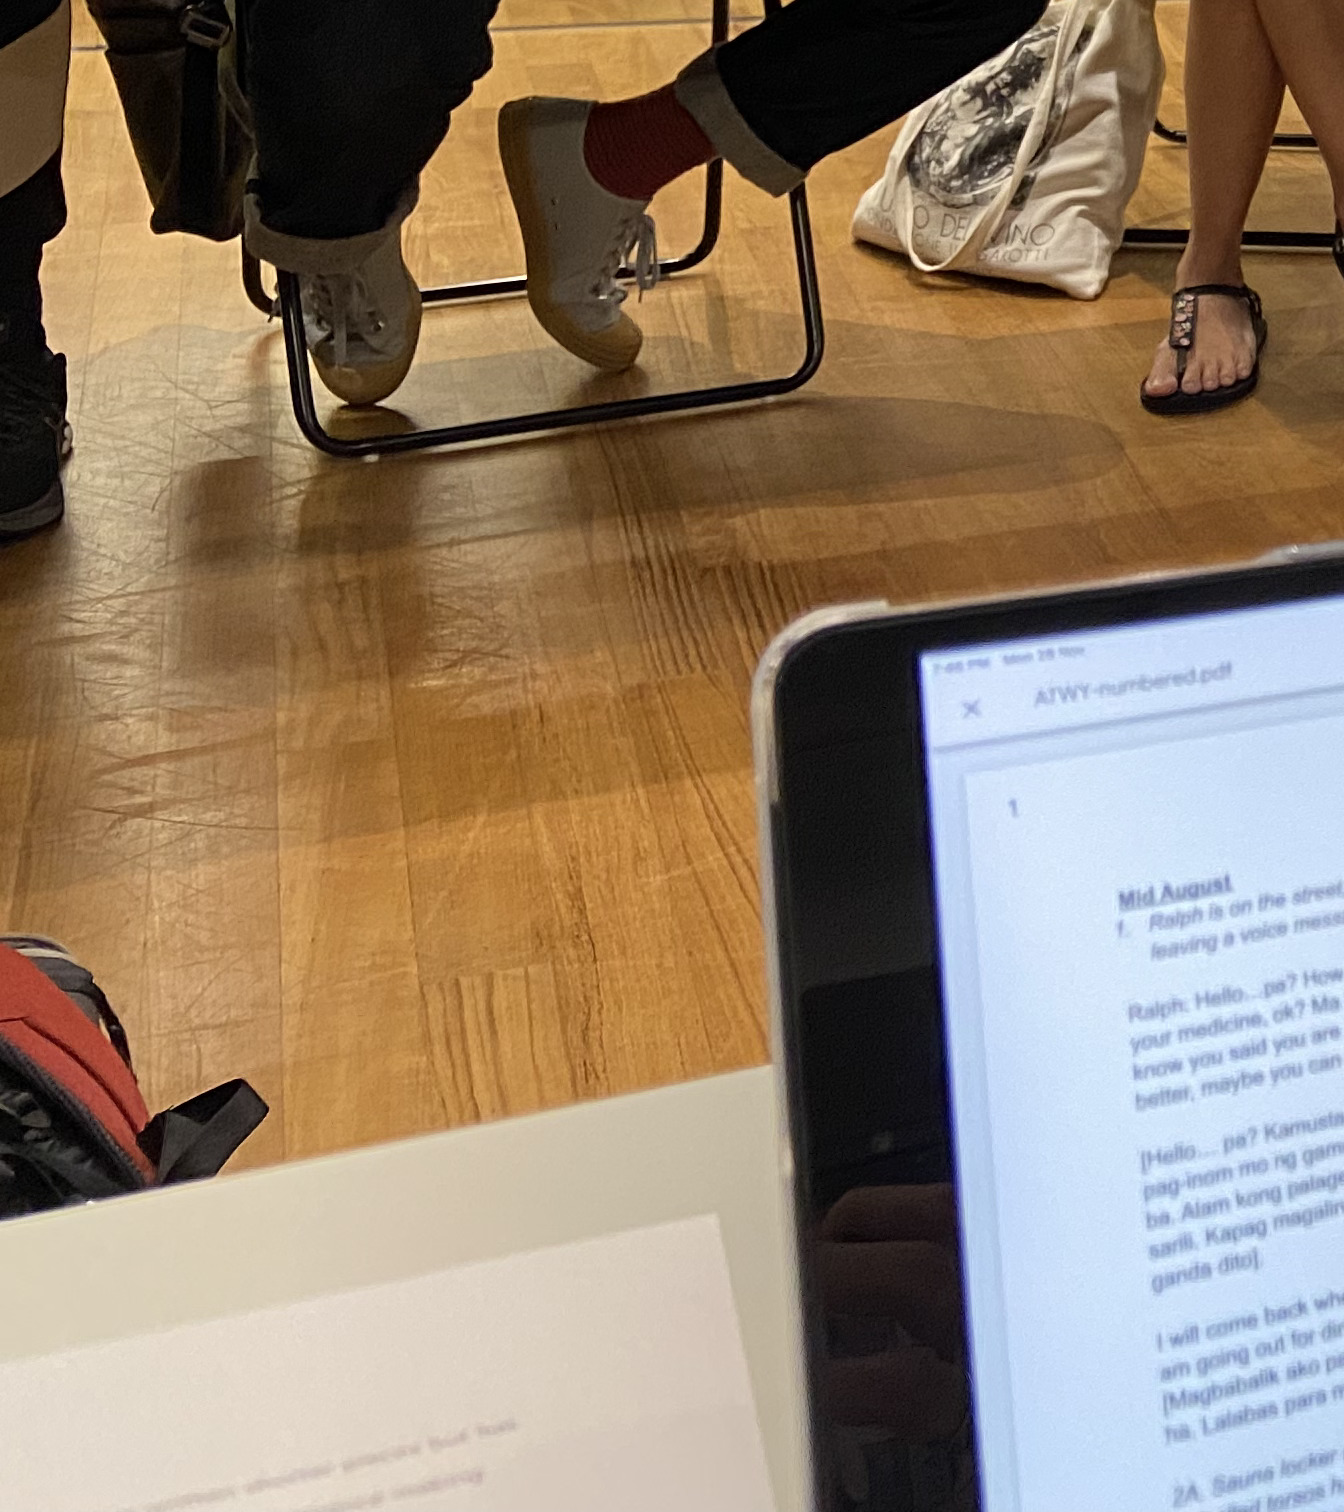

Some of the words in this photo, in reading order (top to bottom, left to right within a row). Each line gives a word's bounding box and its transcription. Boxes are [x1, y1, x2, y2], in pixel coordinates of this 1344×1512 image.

[1116, 884, 1158, 913] Mid
[1159, 871, 1234, 906] August
[1148, 904, 1205, 933] Ralph
[1207, 902, 1226, 922] is
[1228, 898, 1254, 918] on
[1256, 891, 1287, 912] the
[1149, 932, 1219, 961] leaving
[1239, 920, 1289, 945] voice
[1301, 967, 1344, 989] How
[1128, 1028, 1172, 1057] your
[1131, 1057, 1184, 1081] know
[1187, 1049, 1224, 1075] you
[1227, 1035, 1268, 1063] said
[1271, 1032, 1308, 1058] you
[1309, 1024, 1342, 1045] are
[1199, 1068, 1265, 1097] maybe
[1268, 1061, 1304, 1087] you
[1307, 1052, 1343, 1075] can
[1167, 1322, 1200, 1349] will
[1204, 1312, 1259, 1341] come
[1262, 1296, 1309, 1327] back
[1194, 1343, 1251, 1378] going
[1253, 1333, 1286, 1360] out
[1289, 1328, 1316, 1349] for
[1210, 1464, 1276, 1498] Sauna
[1278, 1448, 1337, 1479] locker
[1265, 1481, 1326, 1512] torsos
